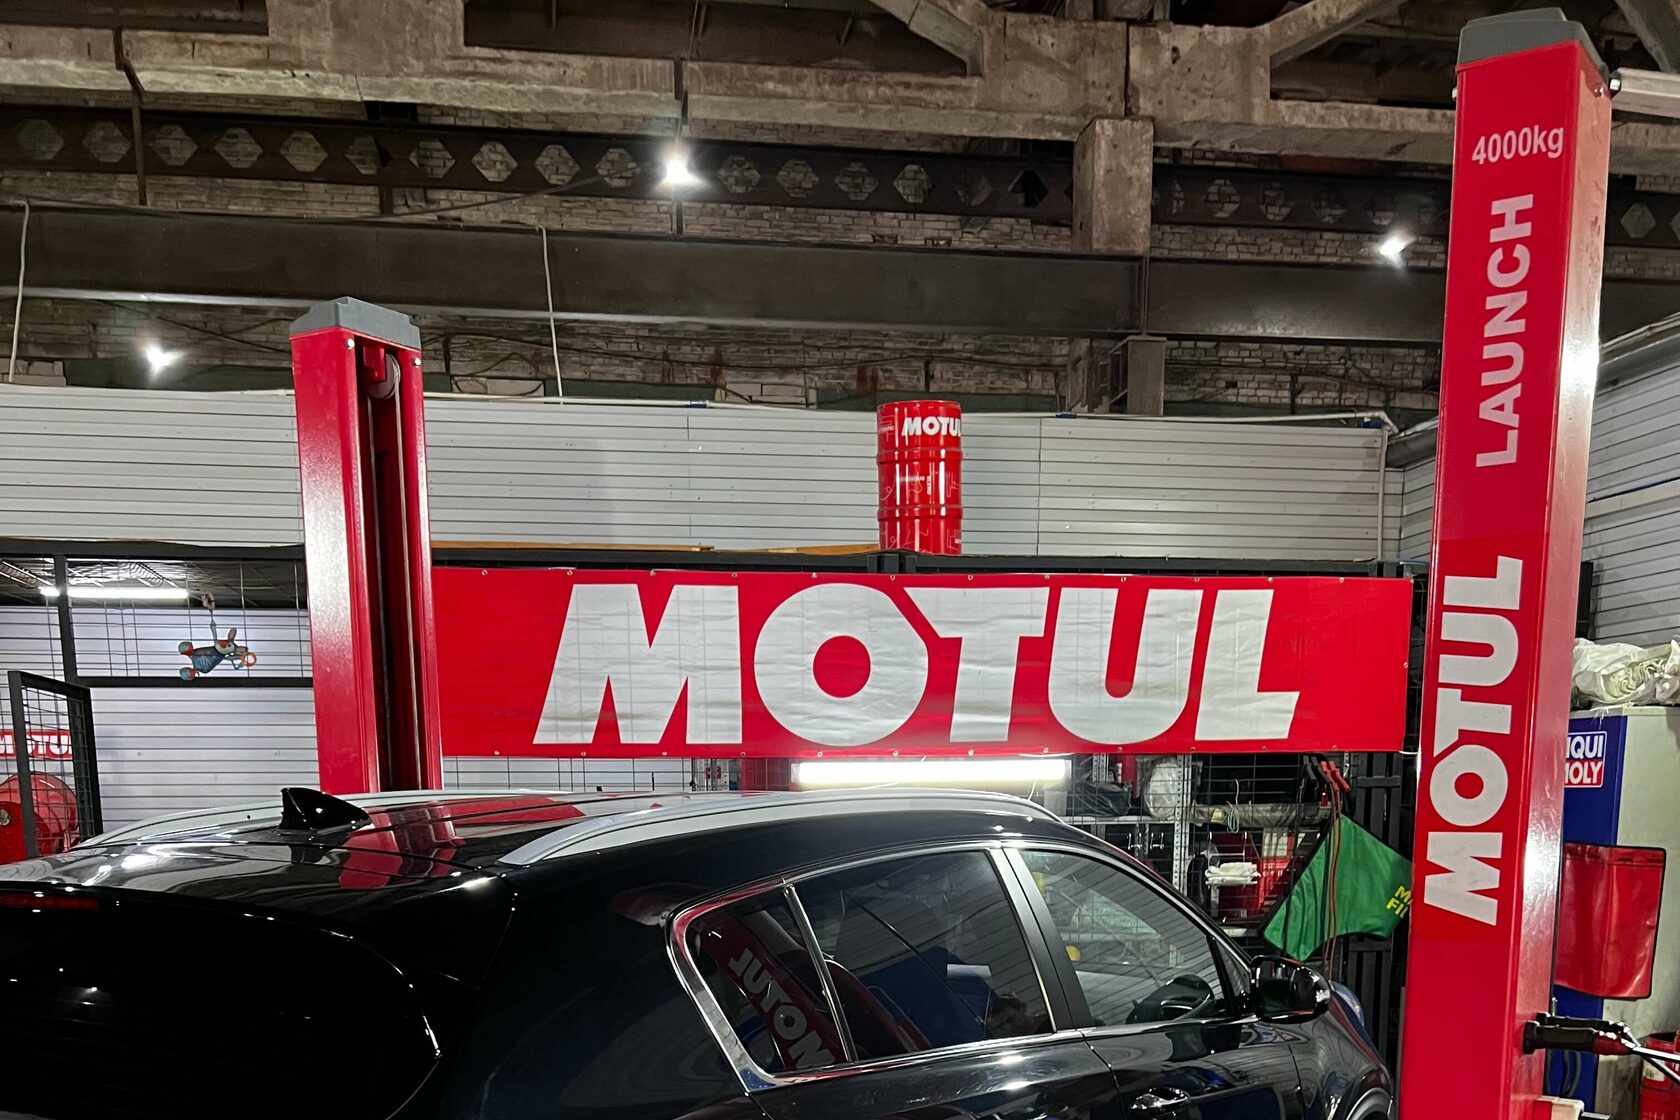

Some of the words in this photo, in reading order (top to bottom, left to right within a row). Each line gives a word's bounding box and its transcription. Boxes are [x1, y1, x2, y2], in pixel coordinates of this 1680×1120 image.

[1472, 125, 1564, 165] 4000kg
[1475, 194, 1534, 467] LAUNCH
[533, 583, 1300, 747] MOTUL
[1423, 555, 1524, 926] MOTUL
